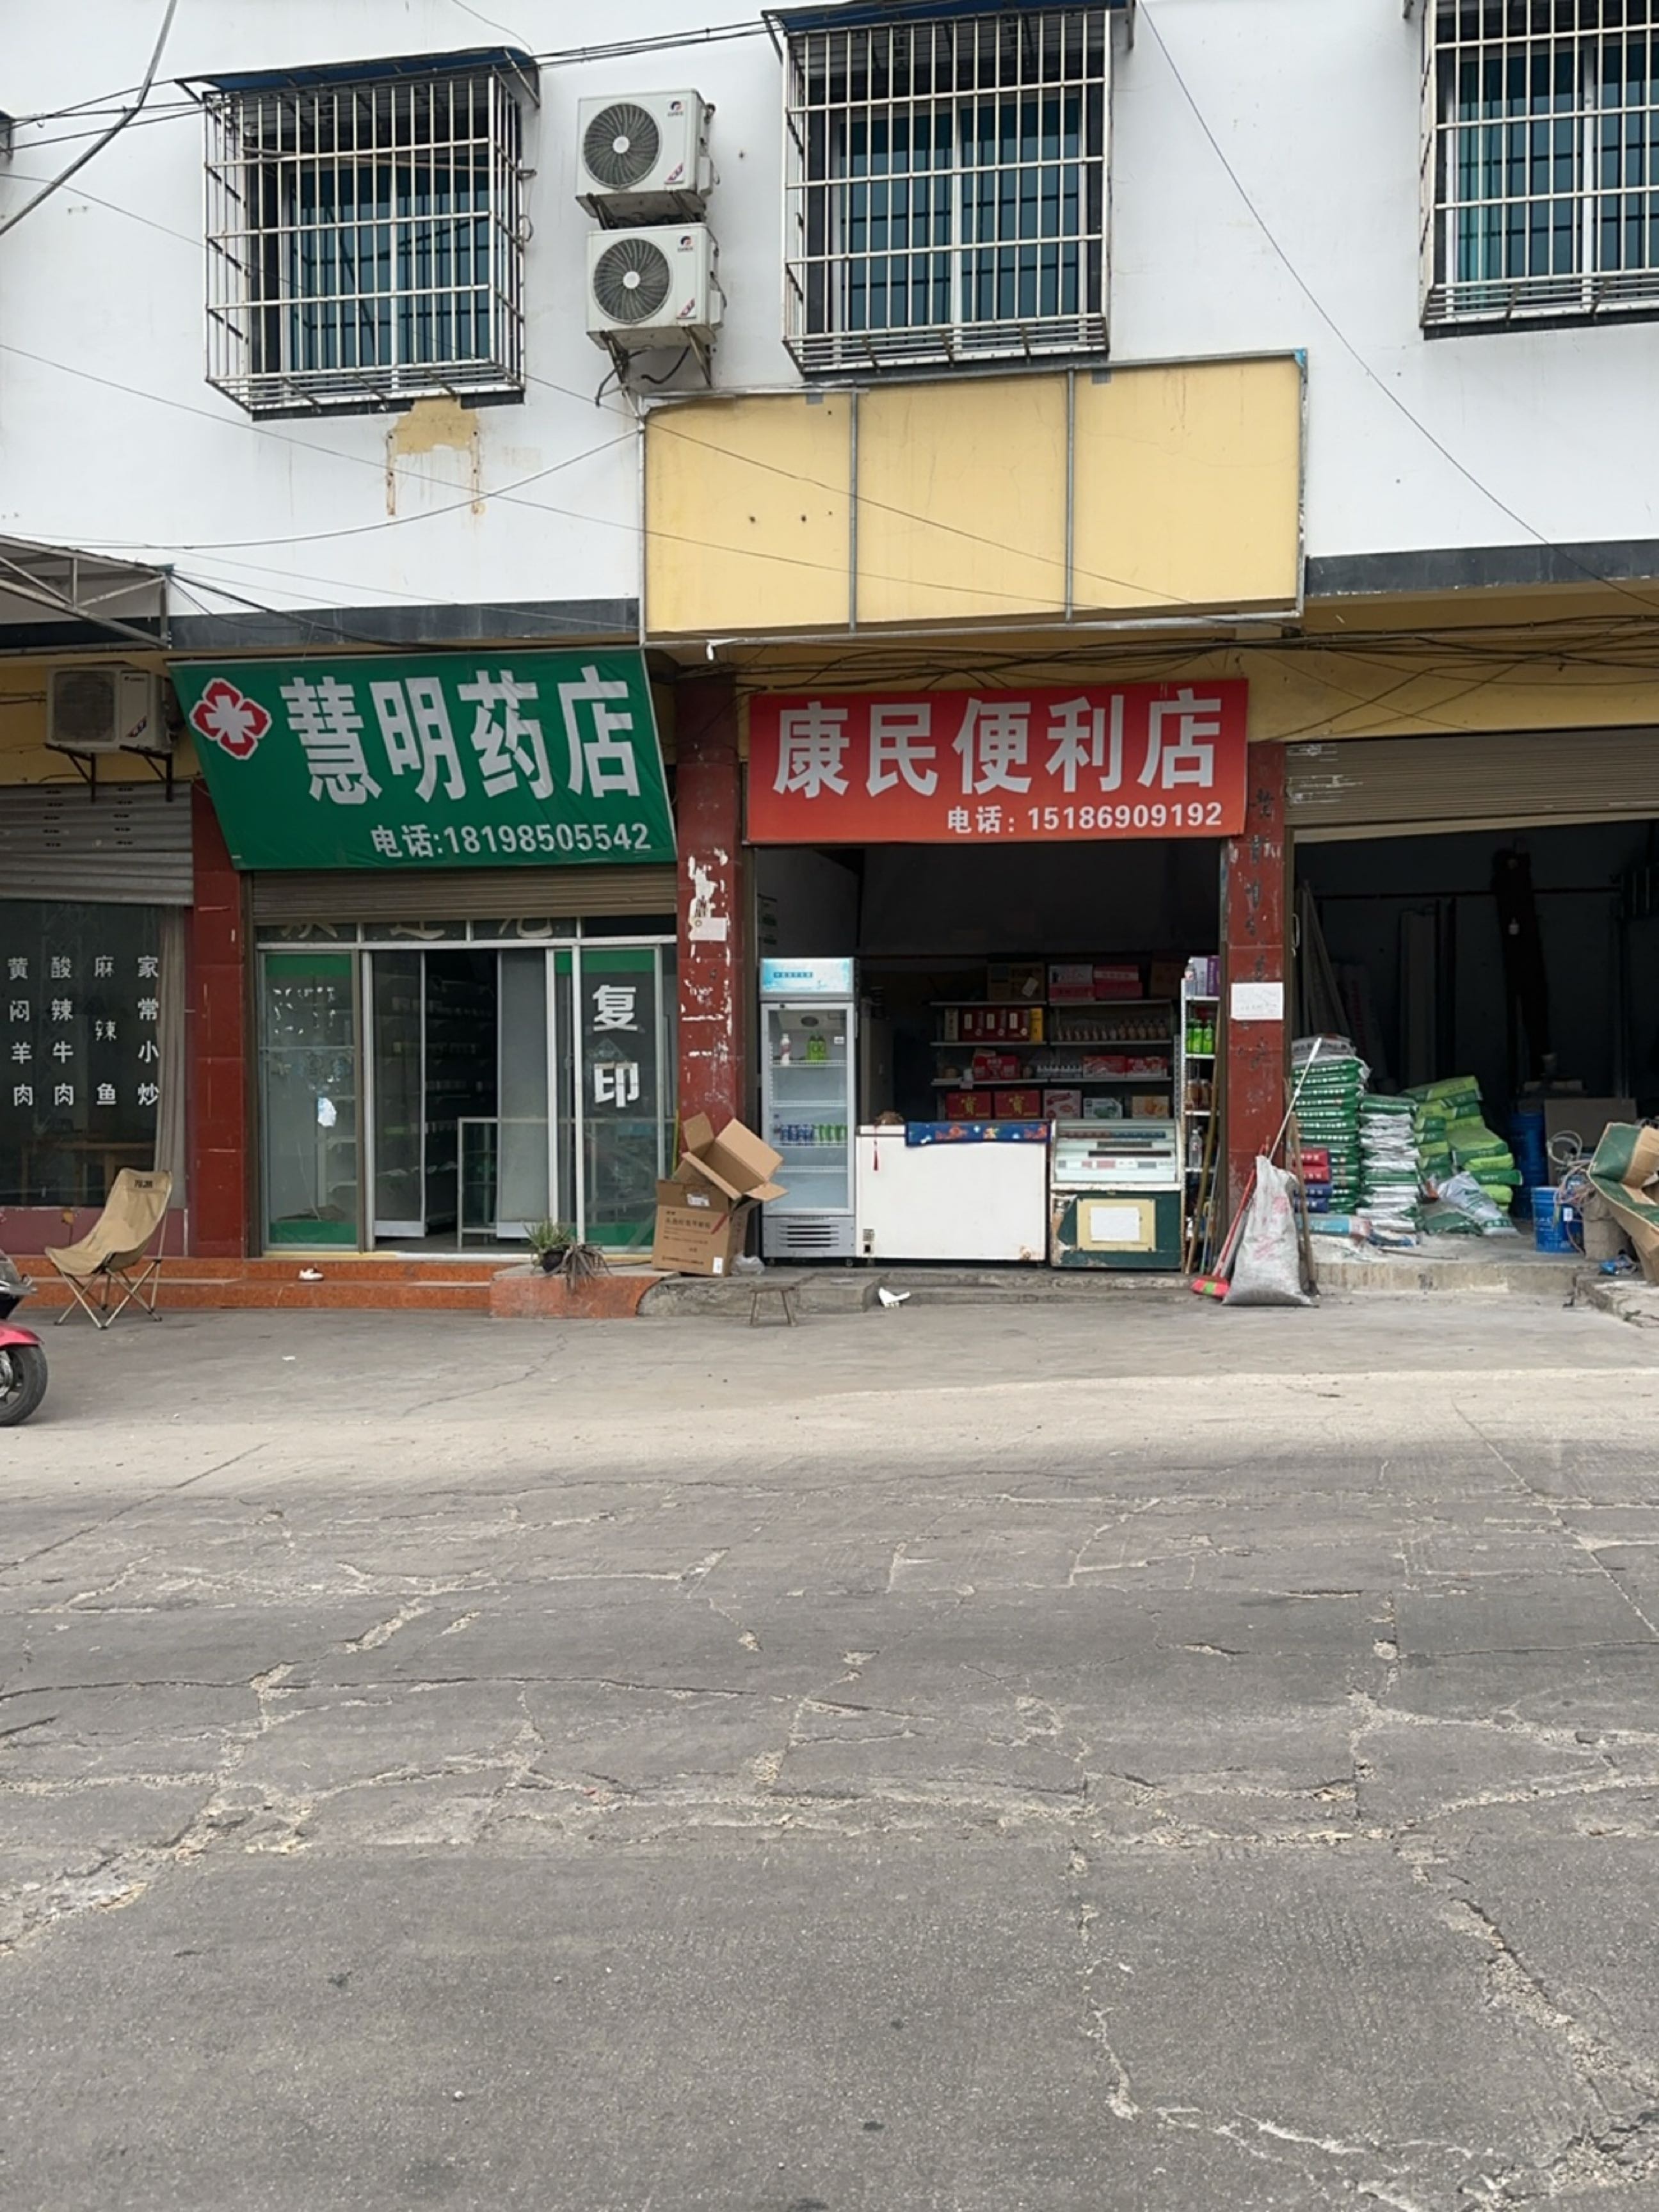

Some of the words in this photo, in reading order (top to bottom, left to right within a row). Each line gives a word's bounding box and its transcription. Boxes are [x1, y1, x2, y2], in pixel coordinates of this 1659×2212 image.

[280, 665, 640, 804] 慧明药店
[773, 689, 1222, 798] 康民便利店
[8, 958, 33, 1106] 黄闷羊肉
[51, 956, 74, 1106] 酸辣牛肉
[95, 955, 117, 1105] 麻辣鱼
[138, 955, 160, 1105] 家常小炒
[591, 984, 641, 1108] 复印
